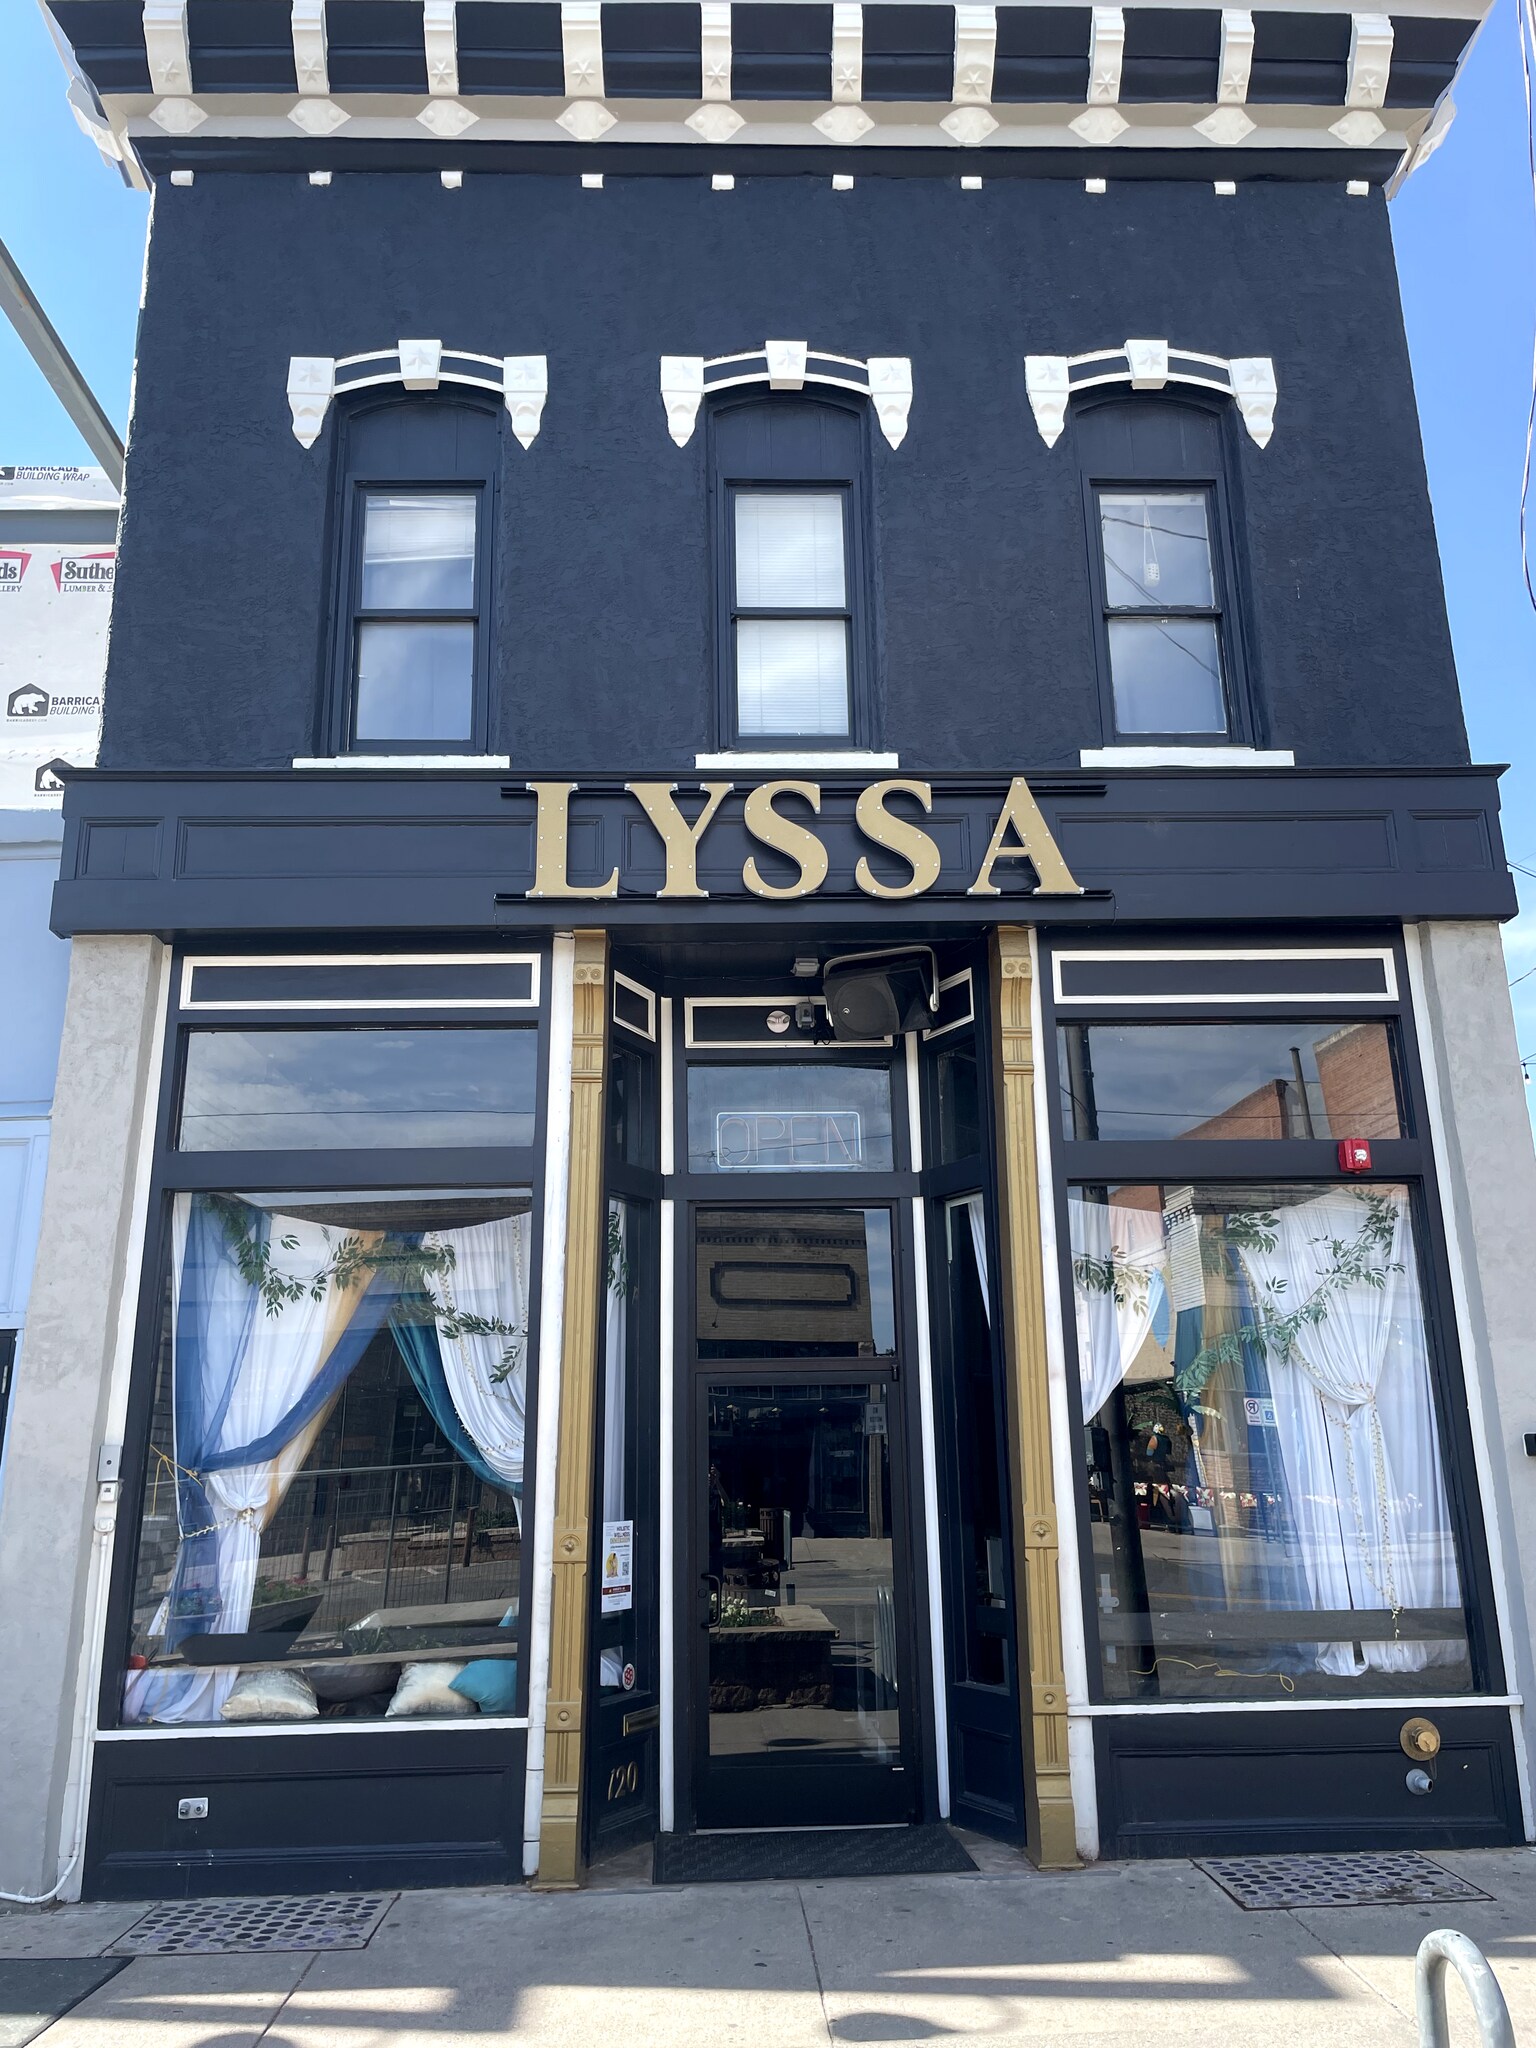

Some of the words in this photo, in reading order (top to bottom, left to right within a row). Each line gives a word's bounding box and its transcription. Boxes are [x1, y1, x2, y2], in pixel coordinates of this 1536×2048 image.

[16, 471, 60, 480] BUILDING
[62, 473, 90, 481] WRAP
[98, 584, 105, 592] &
[51, 697, 100, 705] BARRICA
[49, 706, 95, 715] BUILDING
[525, 777, 1086, 899] LYSSA
[720, 1115, 856, 1164] OPEN
[608, 1761, 637, 1801] 120
